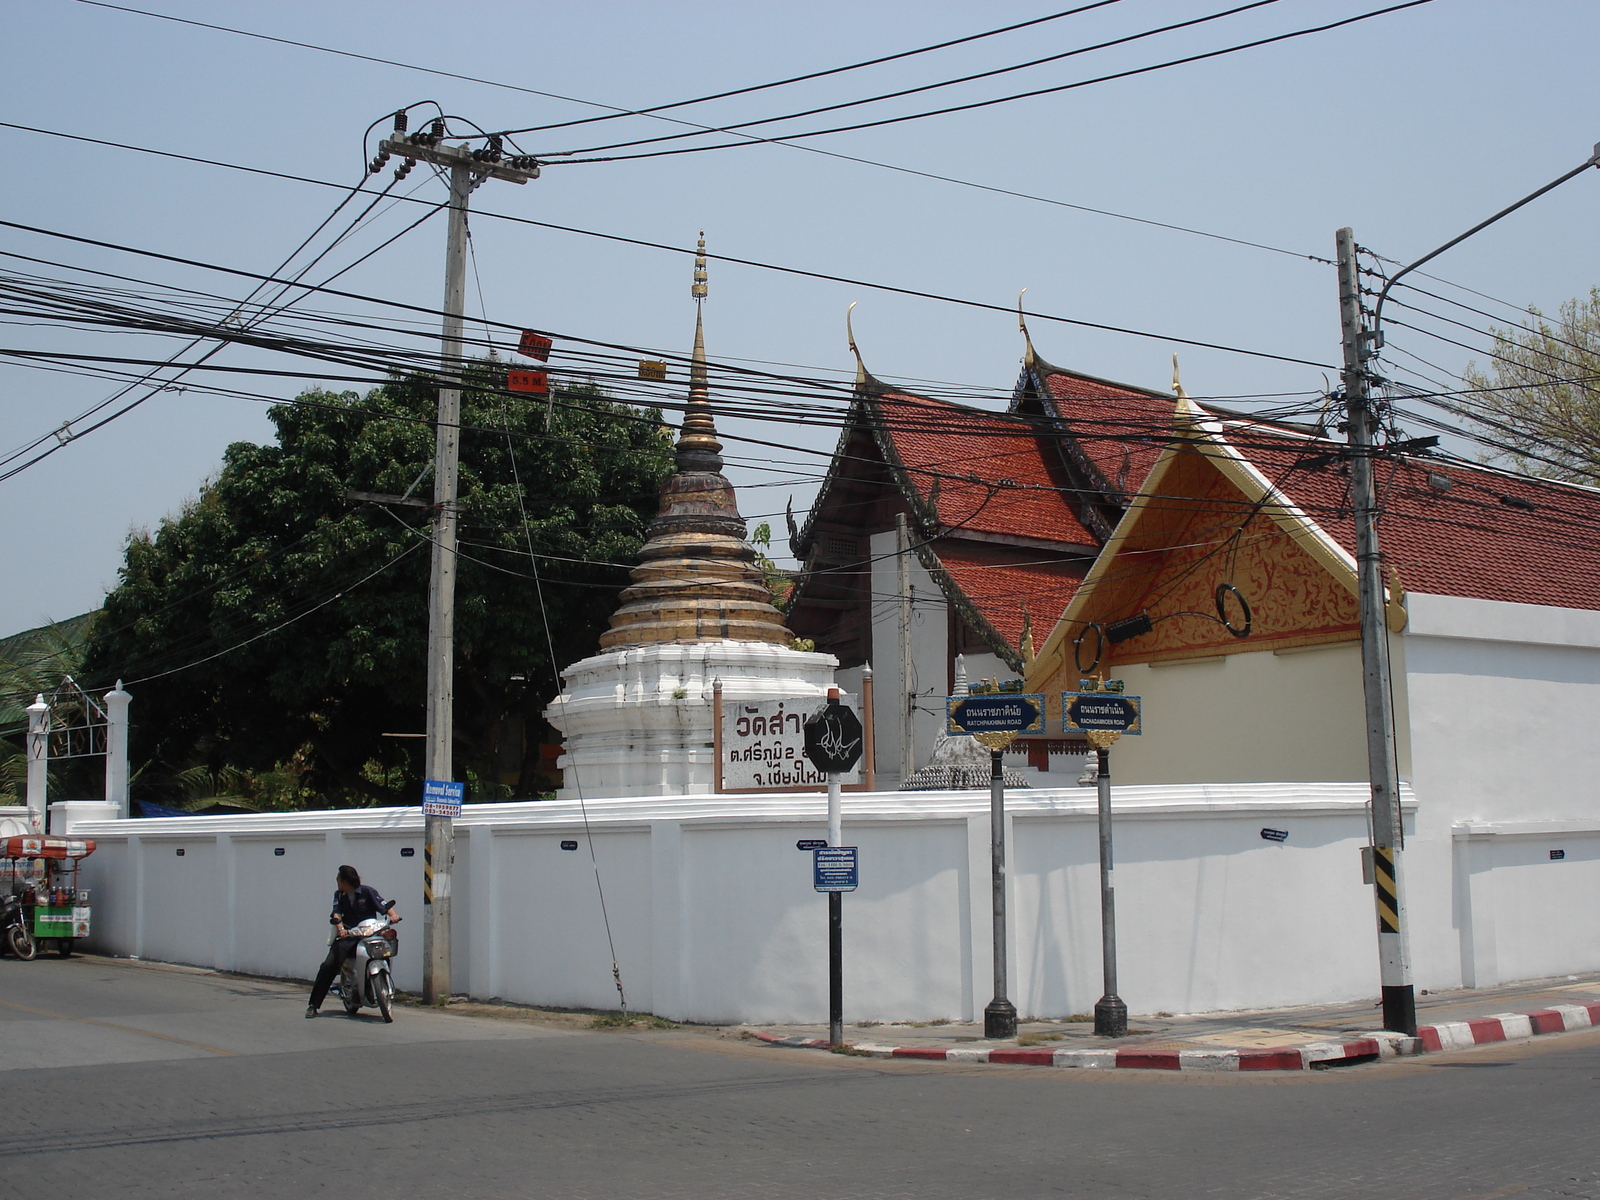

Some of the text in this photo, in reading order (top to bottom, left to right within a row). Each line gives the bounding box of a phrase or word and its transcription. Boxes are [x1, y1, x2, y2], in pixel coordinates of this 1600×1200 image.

[512, 376, 529, 386] 5.5
[966, 704, 1022, 717] ถนนราชภาคินัย
[1080, 703, 1125, 715] ถนนราชดำเนิน
[426, 783, 461, 797] Removal Service
